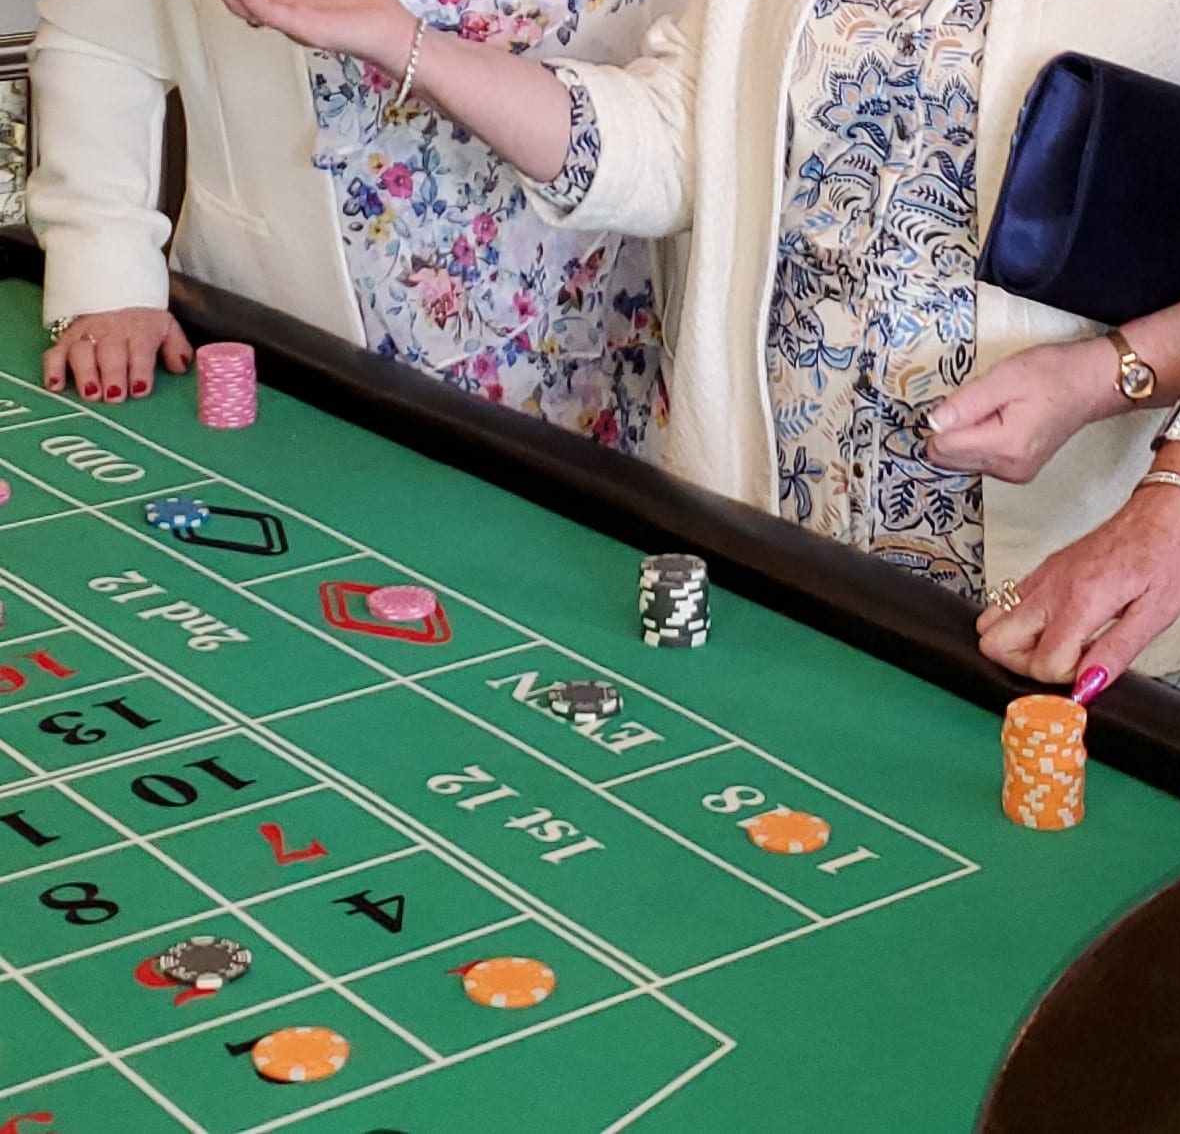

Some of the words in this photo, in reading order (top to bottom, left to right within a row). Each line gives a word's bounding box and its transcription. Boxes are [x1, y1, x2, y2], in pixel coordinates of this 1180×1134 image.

[41, 435, 146, 483] ODD
[88, 570, 168, 604] 12
[151, 600, 252, 653] 2nd
[38, 696, 162, 746] 13
[485, 670, 666, 756] EVN
[130, 756, 257, 808] 10
[426, 764, 521, 811] 12
[258, 822, 330, 866] 7
[503, 807, 606, 865] 1st
[815, 845, 881, 876] 1
[38, 881, 120, 926] 8
[331, 889, 406, 934] 4
